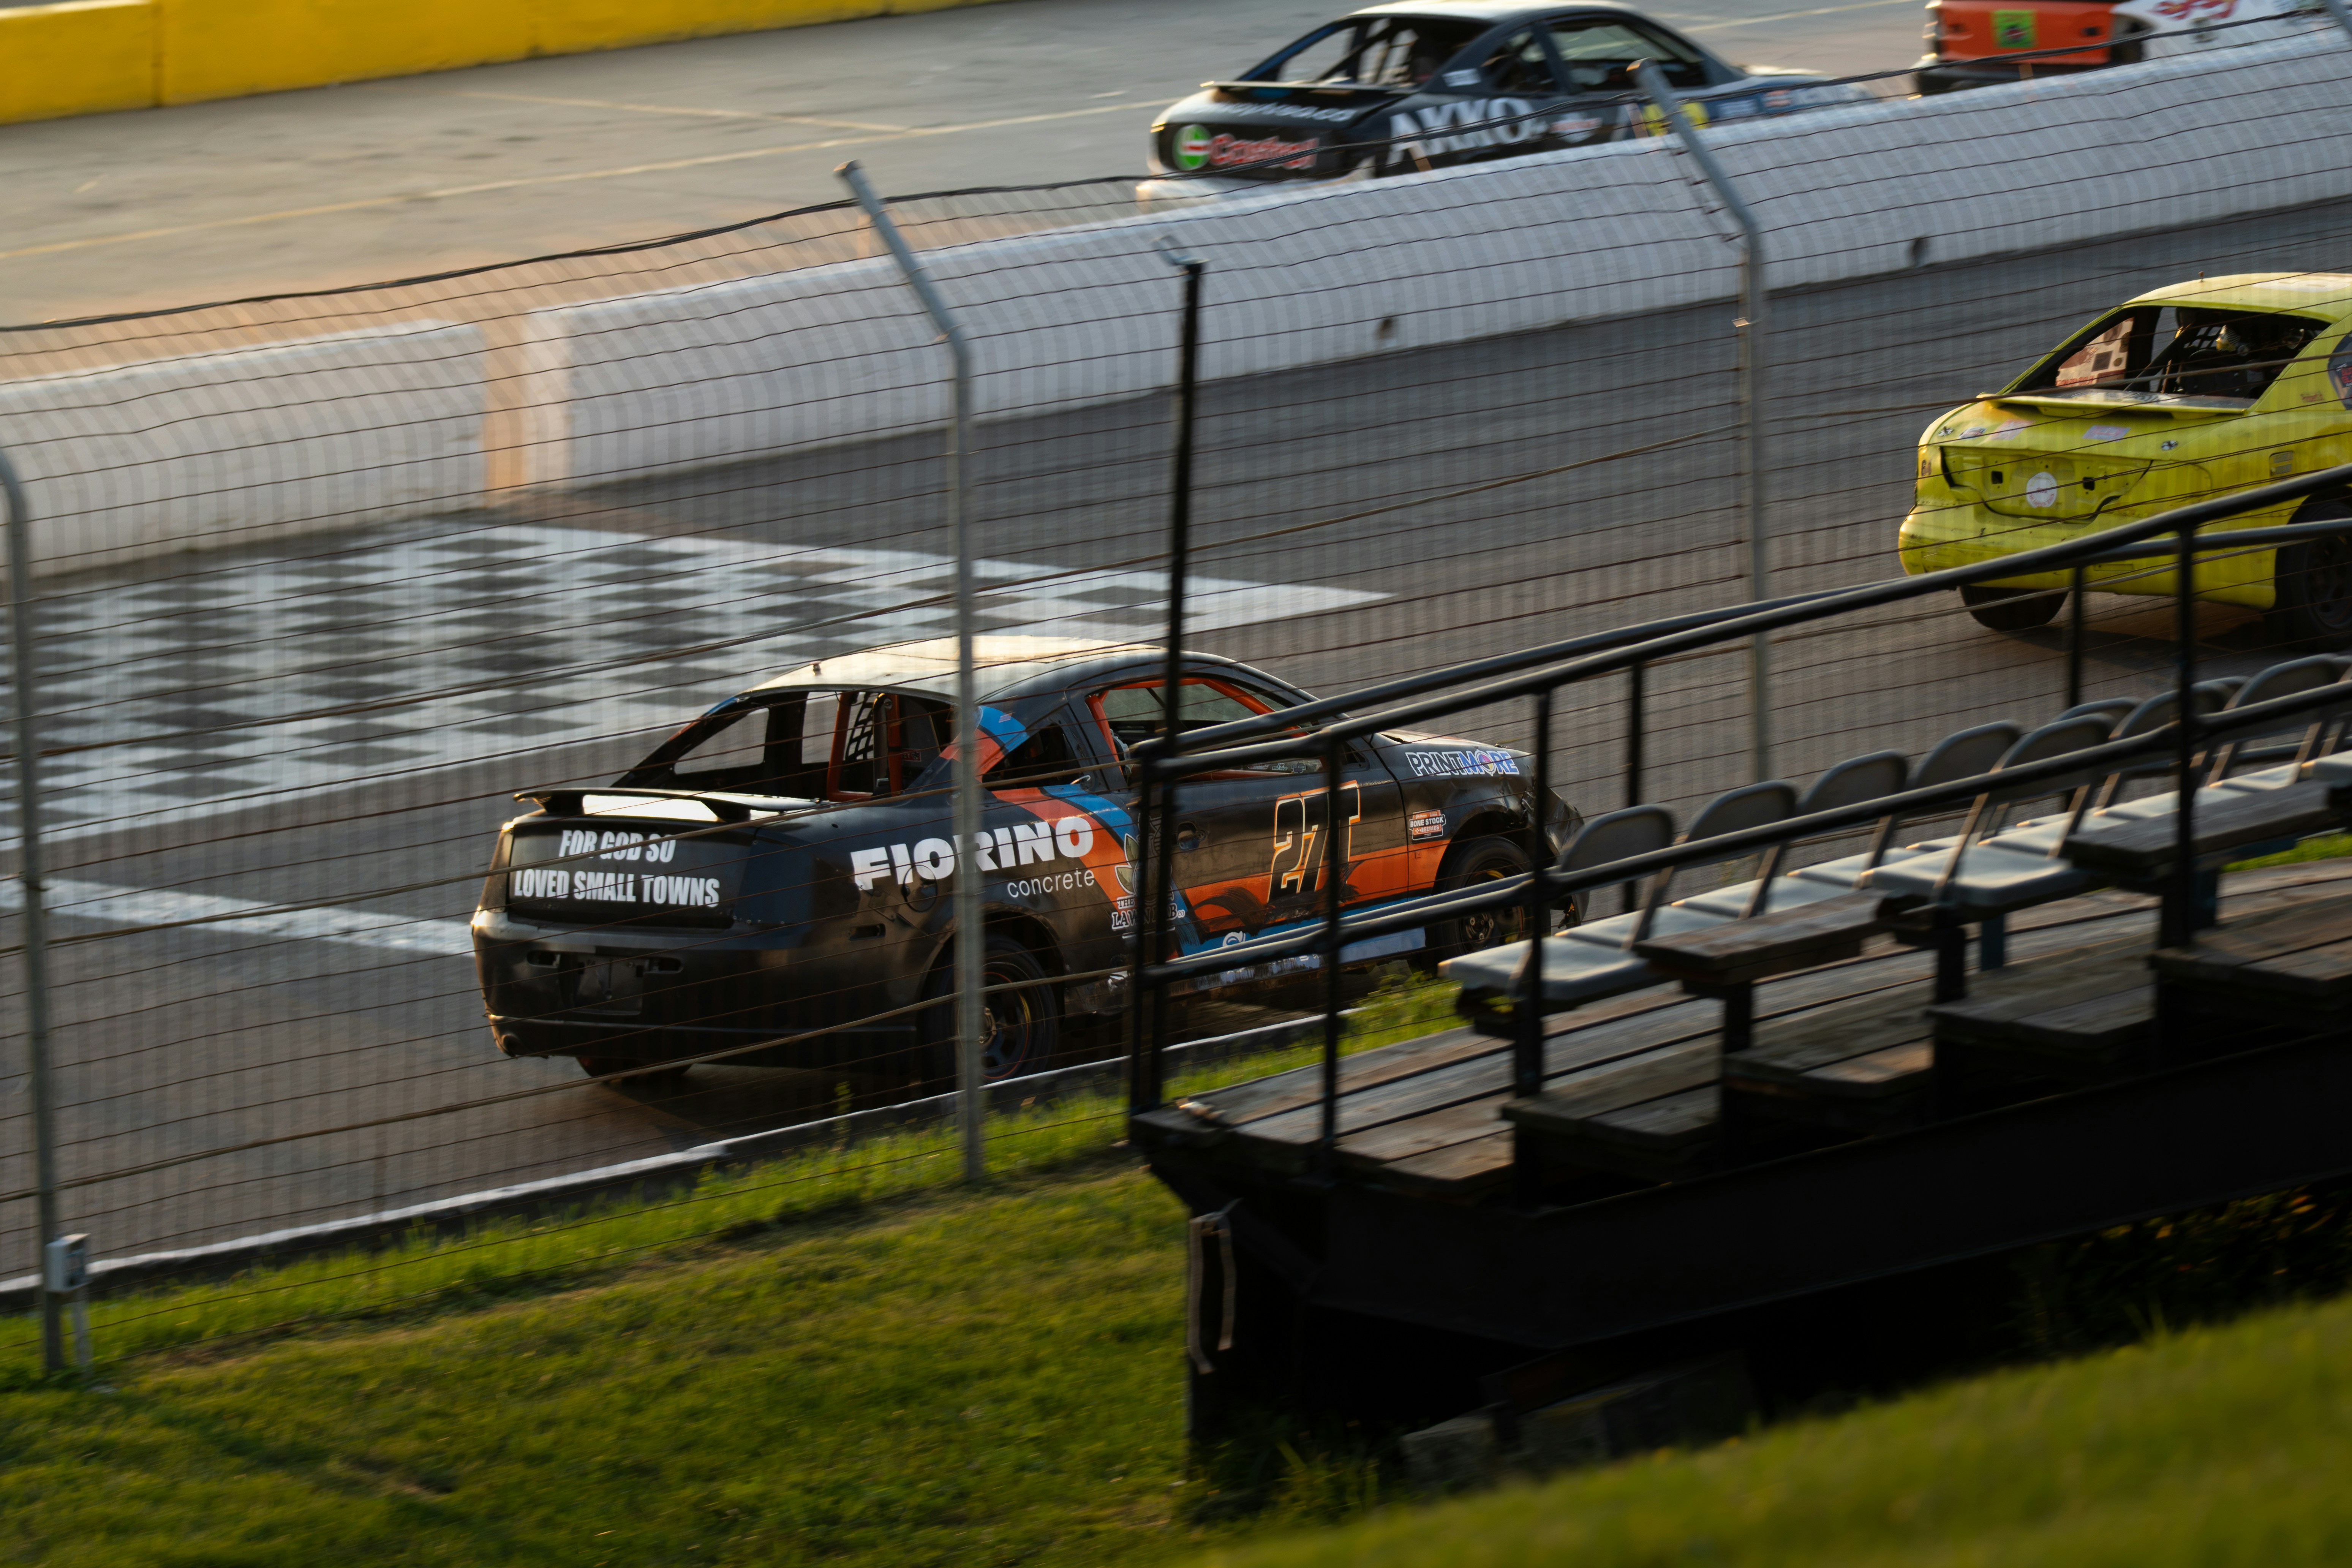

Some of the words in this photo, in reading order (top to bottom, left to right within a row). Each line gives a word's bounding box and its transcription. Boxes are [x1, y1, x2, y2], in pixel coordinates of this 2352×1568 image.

[1405, 749, 1520, 777] PRINTMORE
[1410, 819, 1425, 828] BONE
[1425, 816, 1444, 825] STOCK
[558, 830, 596, 859] FOR
[599, 831, 643, 861] GOD
[645, 834, 677, 863] SO
[850, 816, 1094, 891] FIORINO
[514, 868, 571, 900] LOVED
[573, 870, 637, 903] SMALL
[641, 874, 720, 908] TOWNS
[1007, 867, 1095, 898] concrete
[1118, 897, 1135, 908] THE
